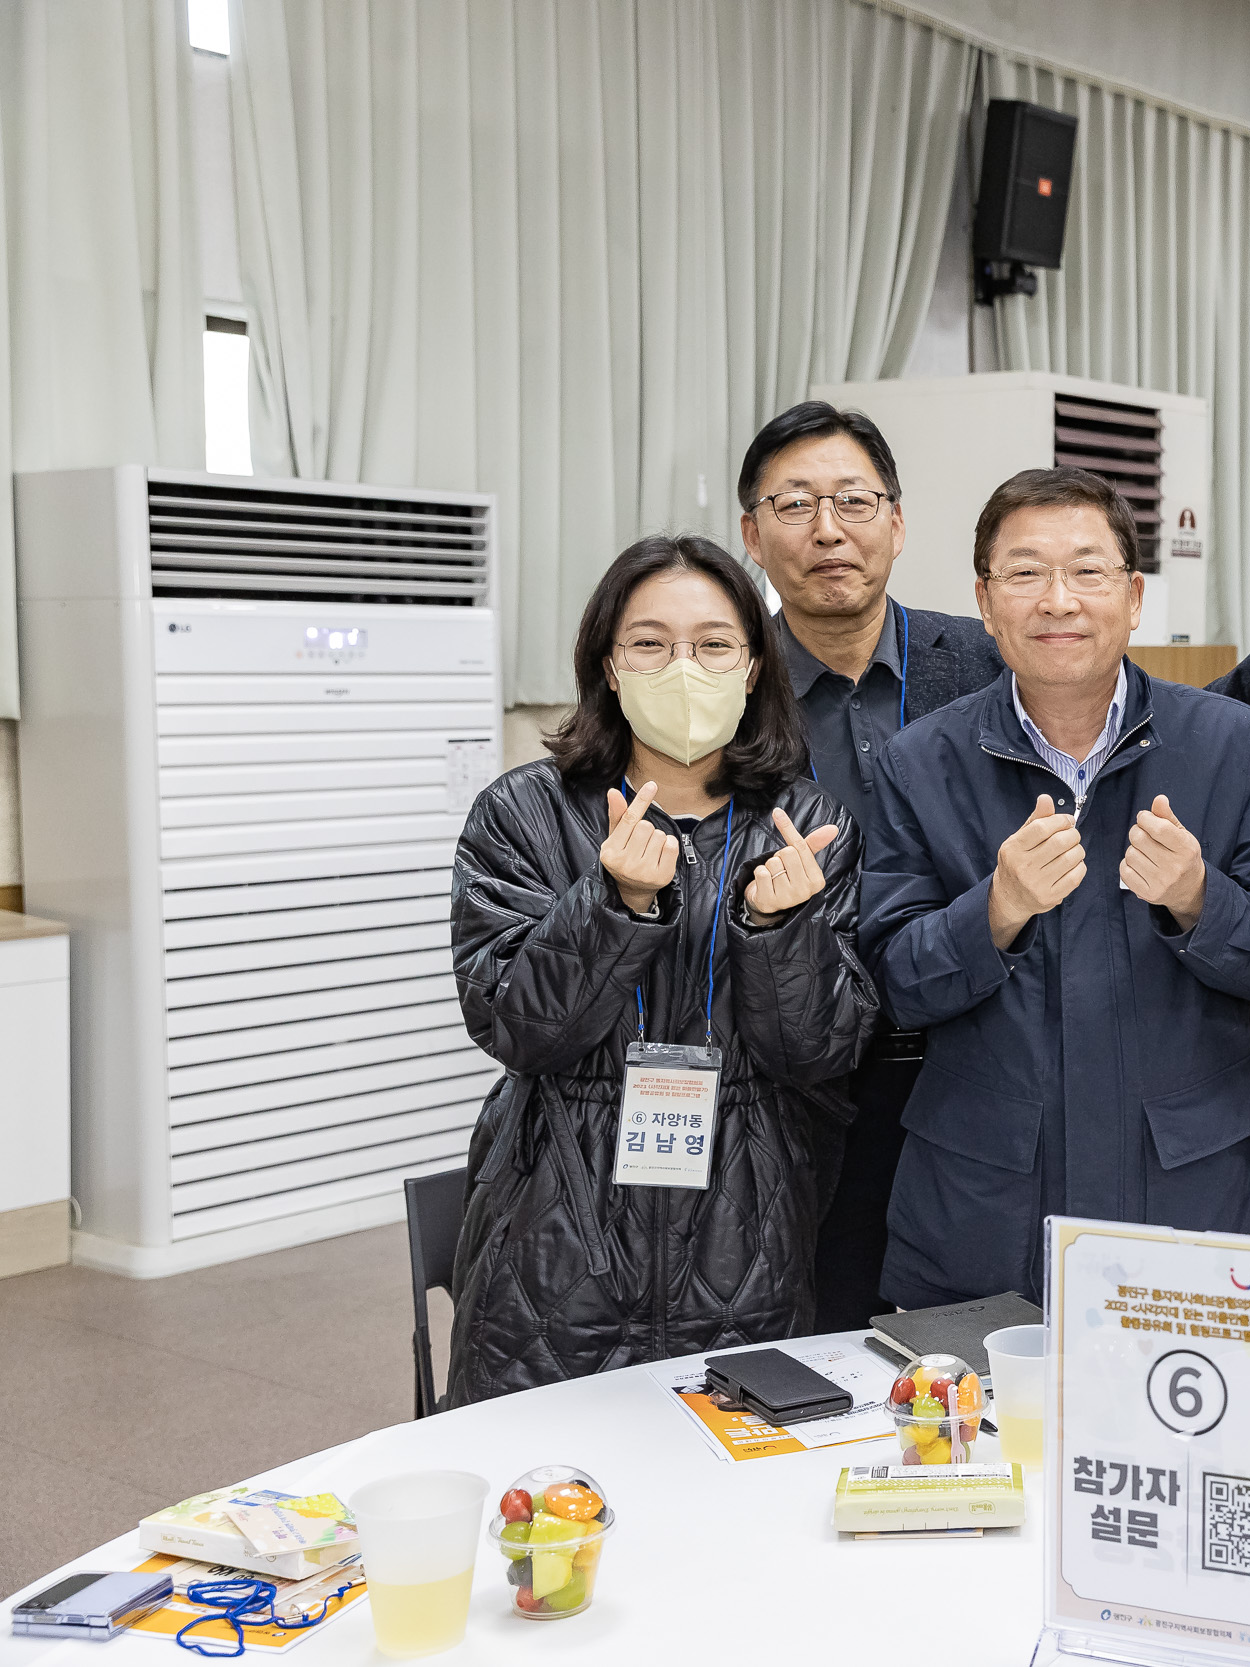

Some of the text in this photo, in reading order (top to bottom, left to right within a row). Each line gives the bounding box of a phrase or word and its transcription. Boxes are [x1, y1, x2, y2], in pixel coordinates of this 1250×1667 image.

[651, 1112, 703, 1128] 자양1동
[1073, 1455, 1181, 1506] 참가자
[1090, 1504, 1159, 1549] 설문
